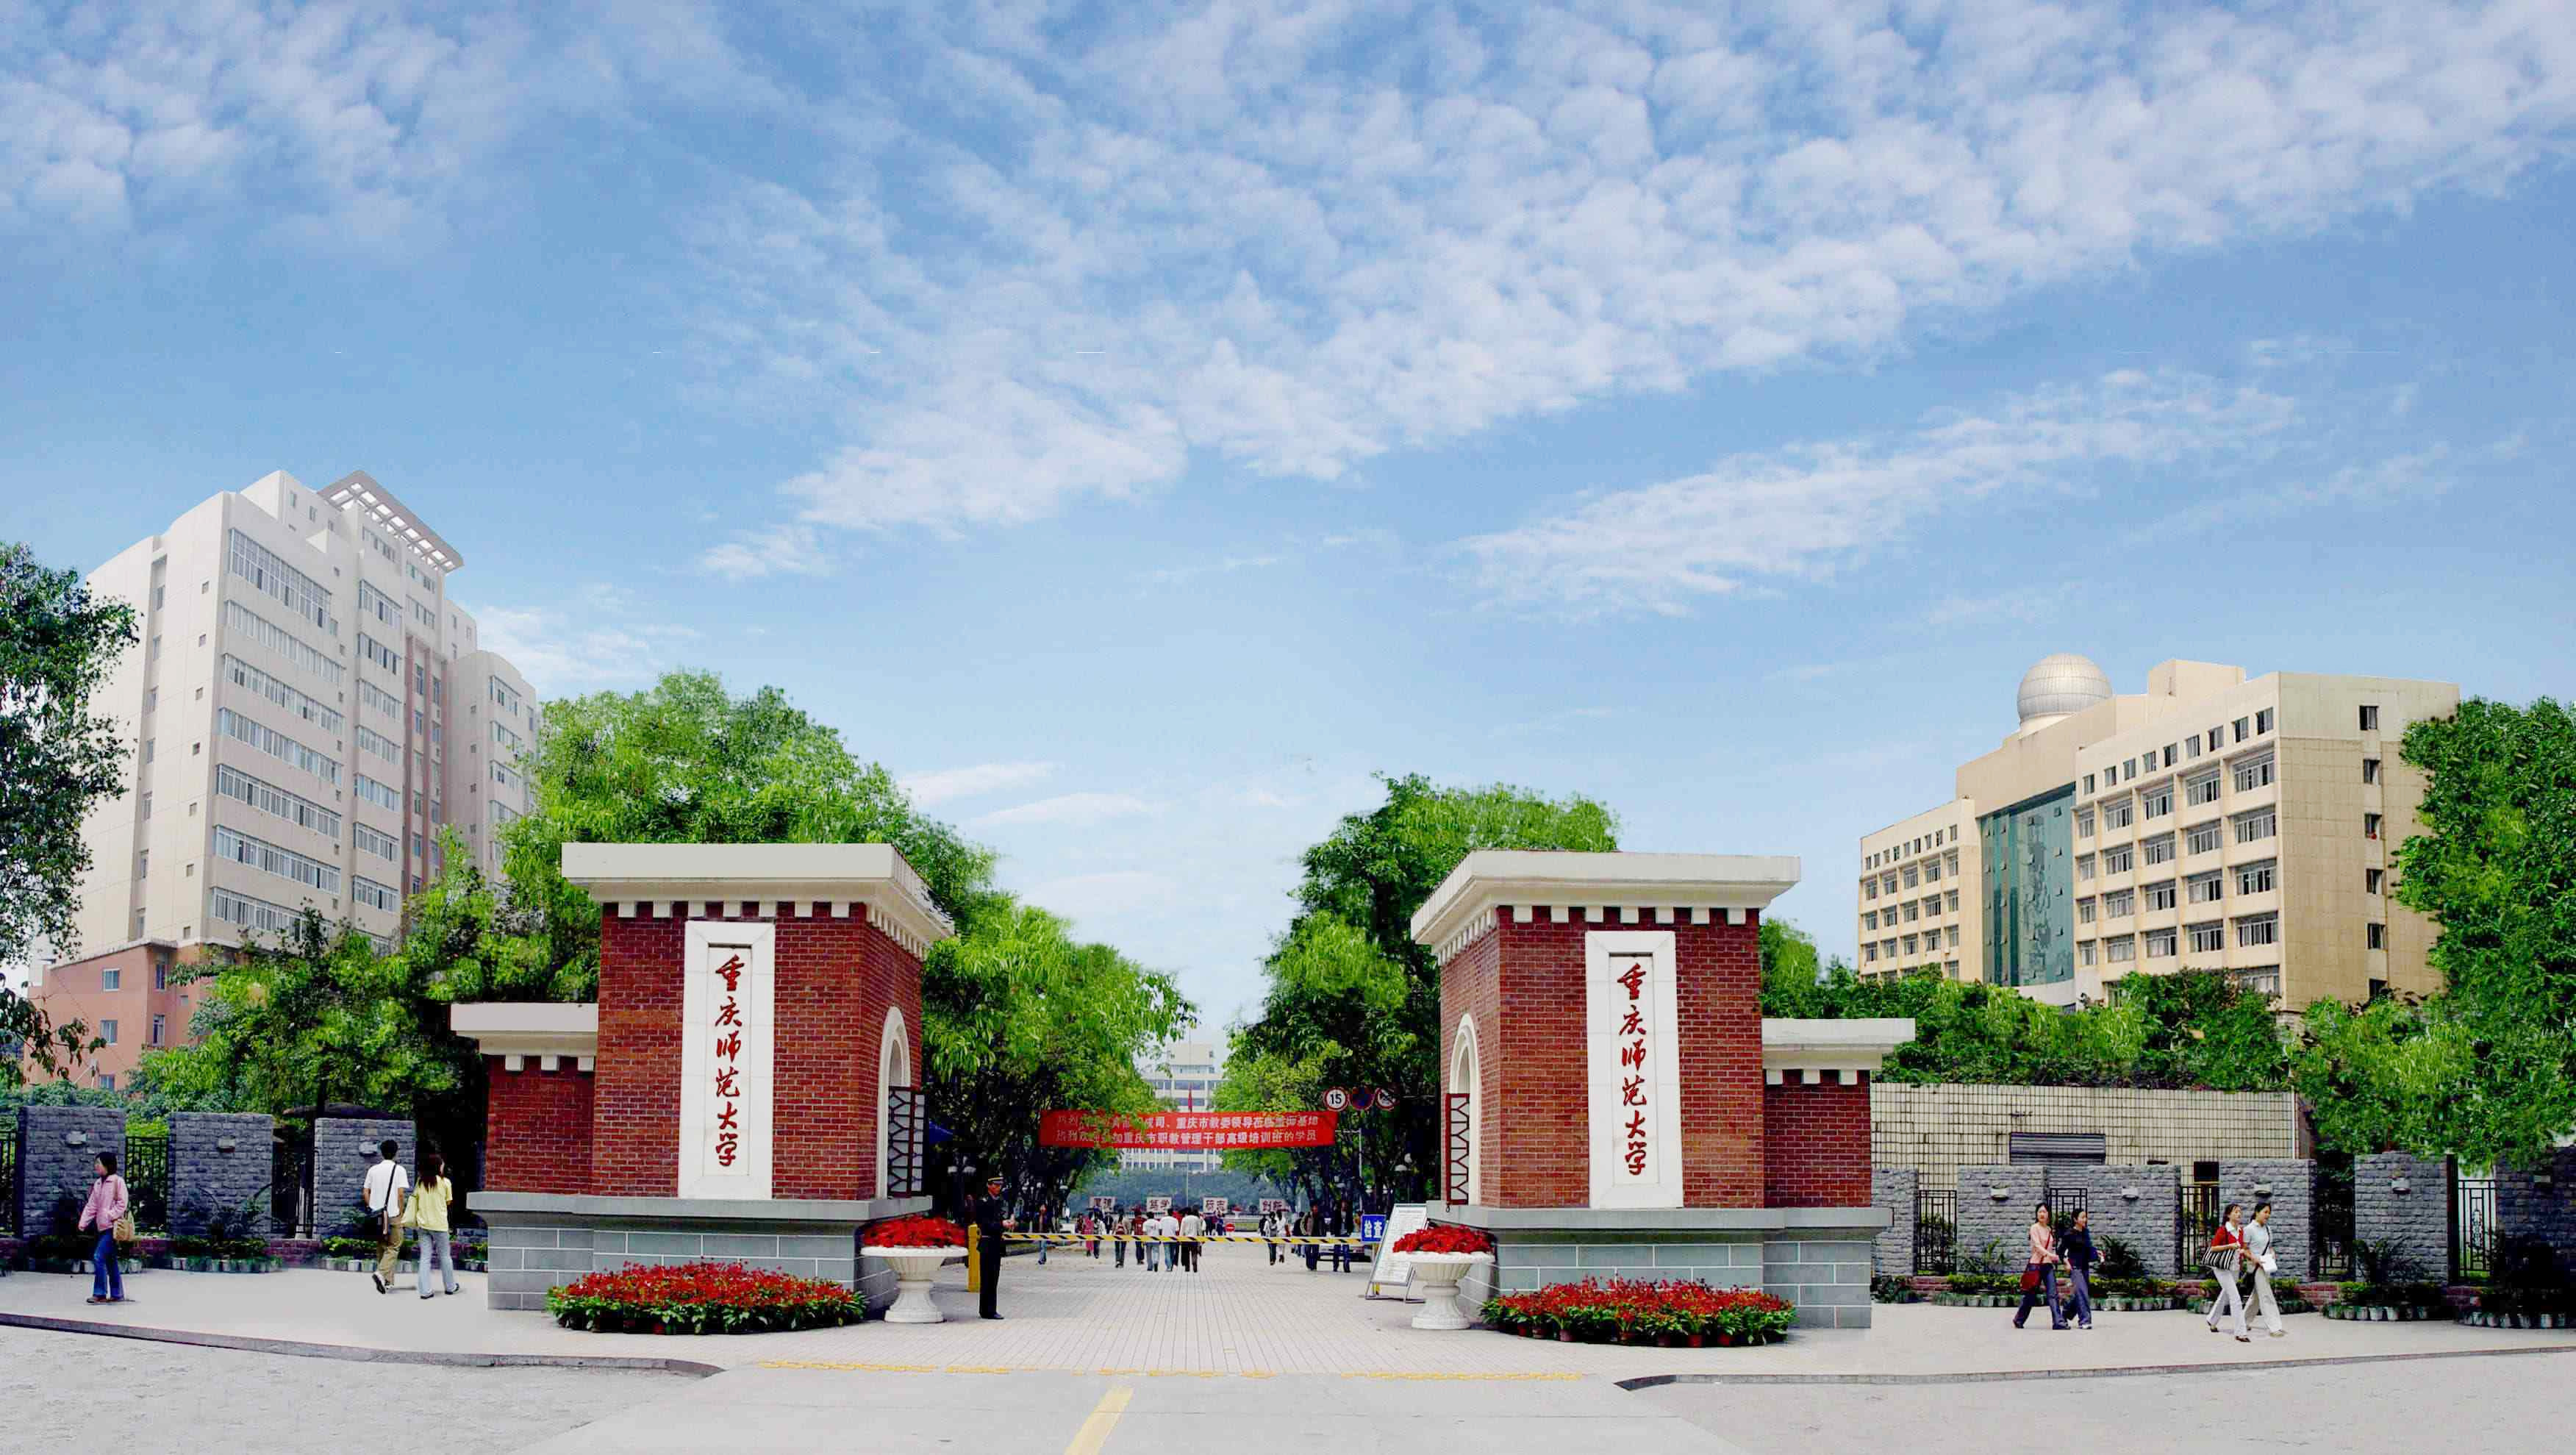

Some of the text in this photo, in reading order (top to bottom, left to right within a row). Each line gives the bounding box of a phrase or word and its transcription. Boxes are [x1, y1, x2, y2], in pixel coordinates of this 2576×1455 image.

[715, 954, 745, 1167] 重庆师范大学
[1329, 1093, 1342, 1104] 15
[1617, 962, 1647, 1176] 重庆师范大学
[1364, 1220, 1383, 1238] 检查
